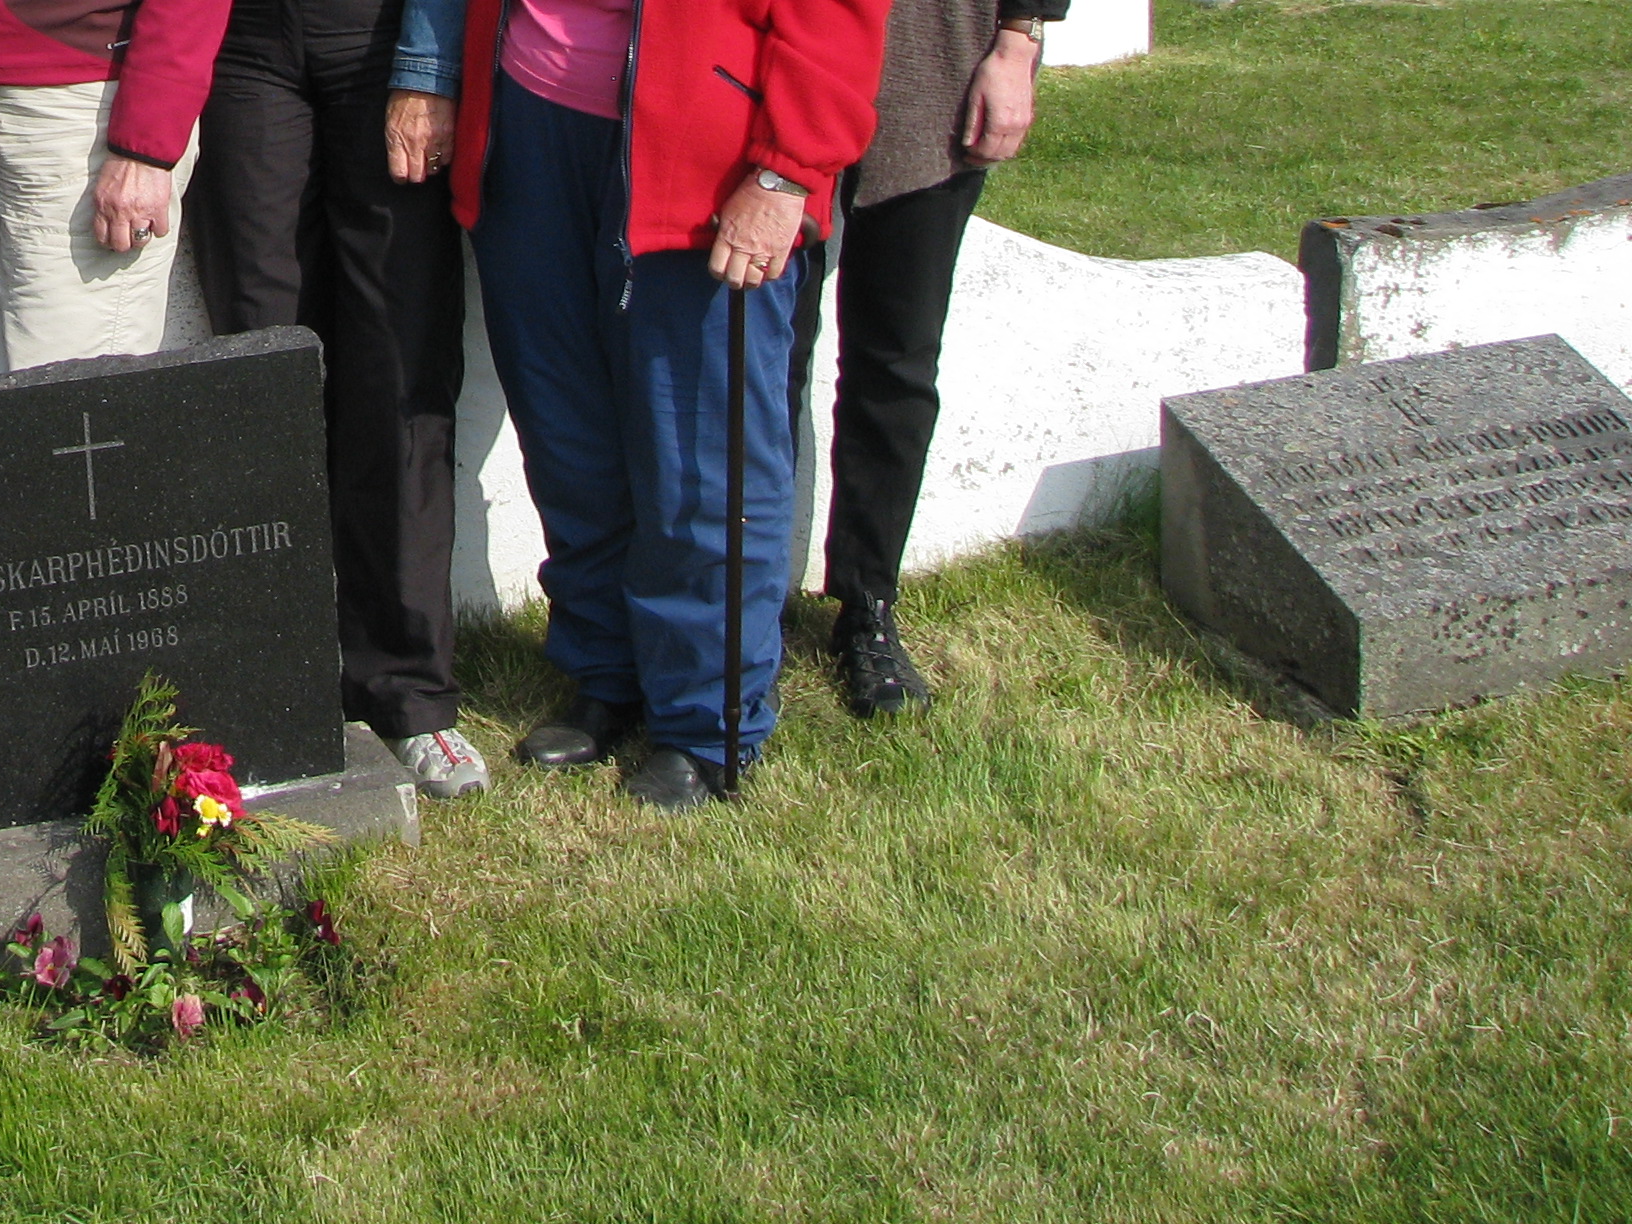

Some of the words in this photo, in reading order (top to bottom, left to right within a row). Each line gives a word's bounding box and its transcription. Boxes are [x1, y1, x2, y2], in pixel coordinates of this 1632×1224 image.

[62, 590, 131, 624] APRÍL
[137, 584, 188, 610] 1888
[80, 628, 120, 660] MAÍ
[127, 626, 179, 651] 1968
